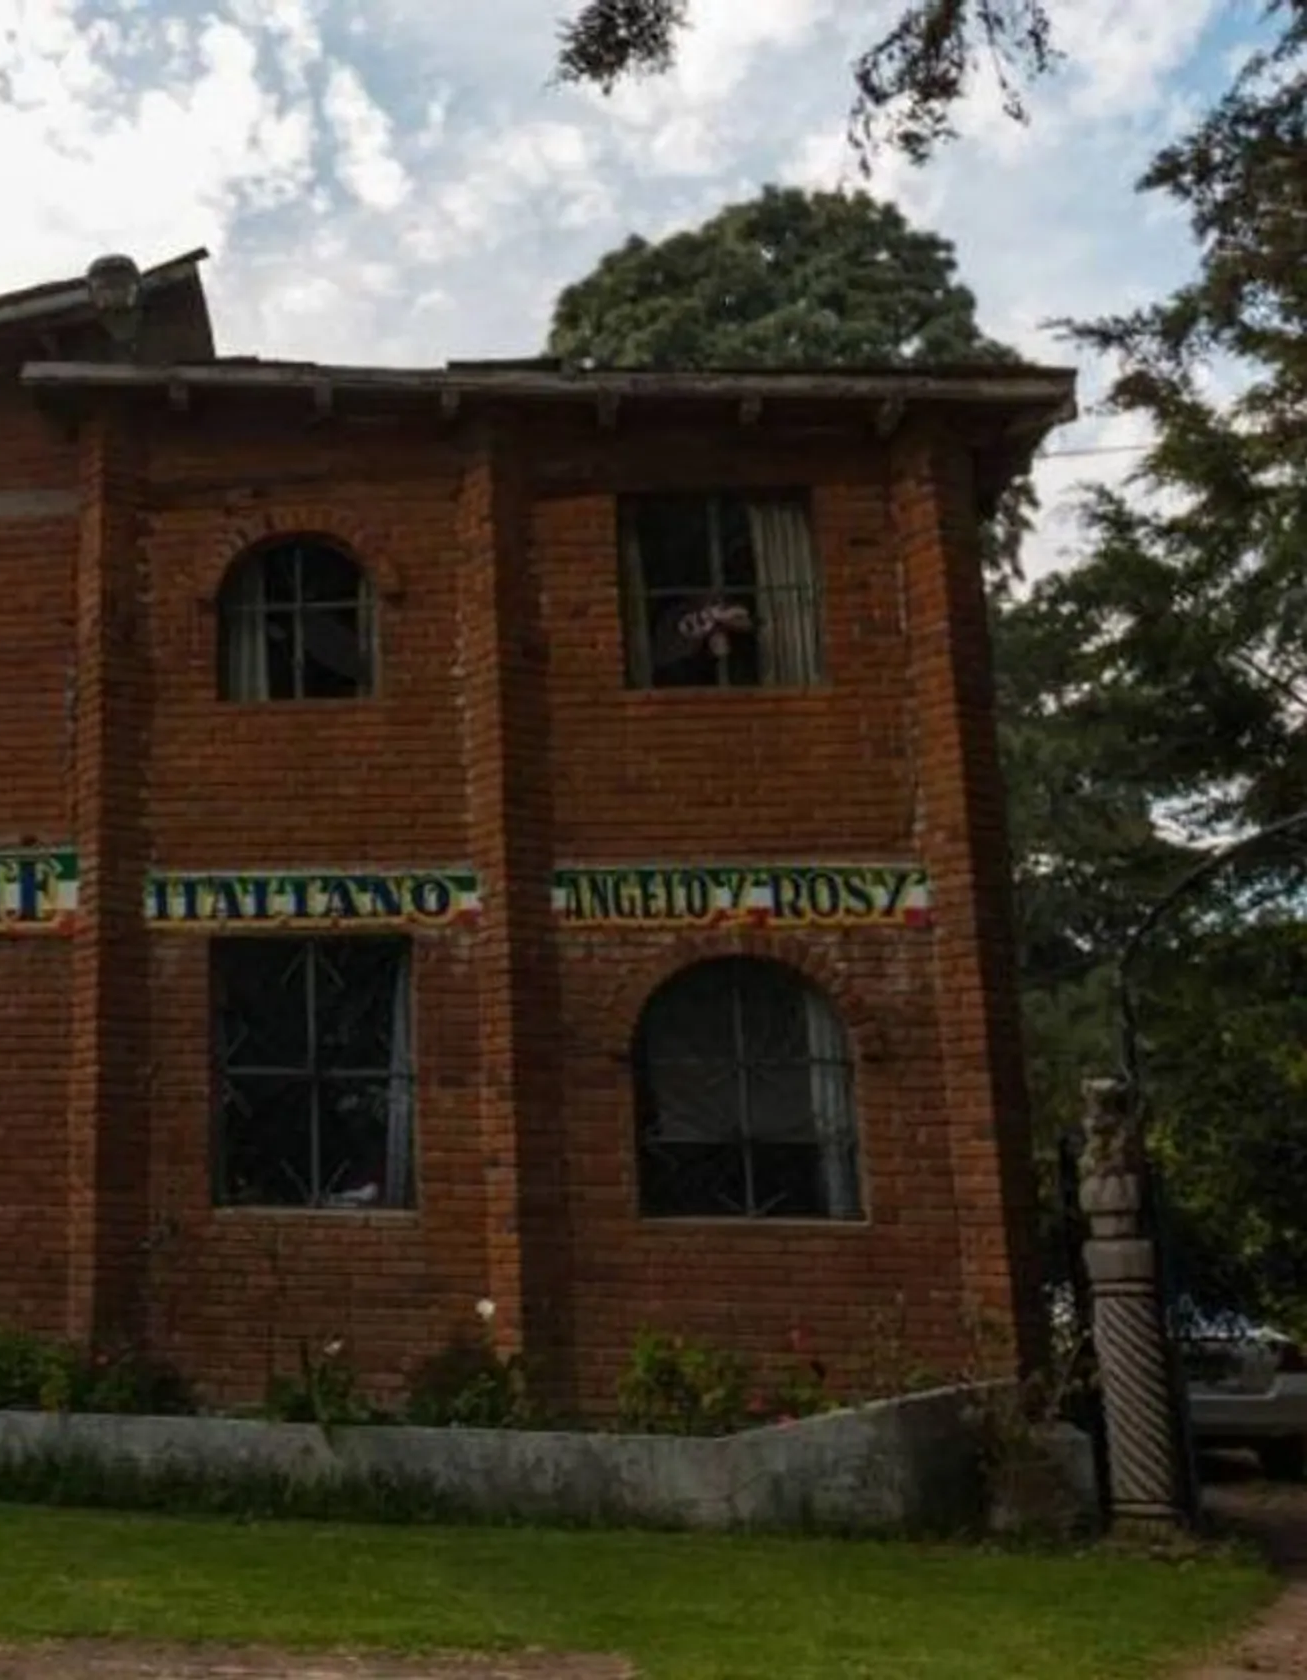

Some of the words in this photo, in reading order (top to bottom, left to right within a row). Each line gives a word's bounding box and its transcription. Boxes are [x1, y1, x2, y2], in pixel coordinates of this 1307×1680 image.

[153, 874, 451, 920] ITALIANO
[567, 869, 711, 921] ANGELO
[720, 871, 750, 911] Y
[770, 870, 910, 920] ROSY
